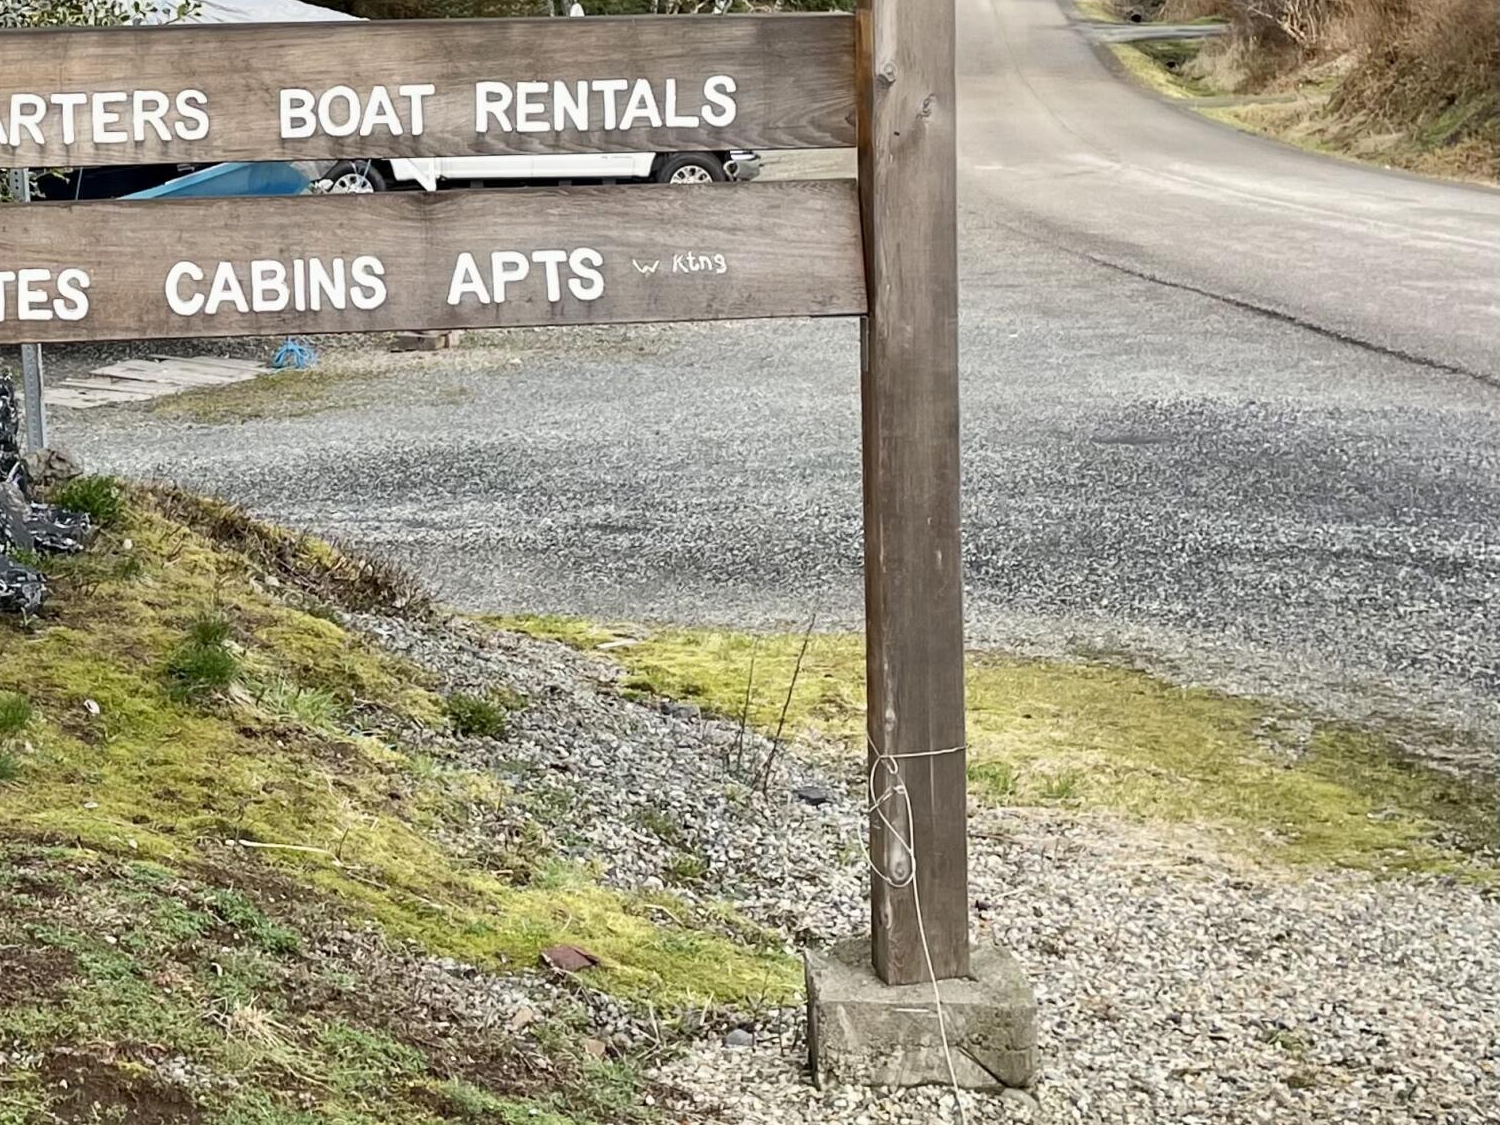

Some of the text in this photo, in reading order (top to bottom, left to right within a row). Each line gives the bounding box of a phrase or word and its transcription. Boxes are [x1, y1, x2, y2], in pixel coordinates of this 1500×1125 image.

[279, 83, 436, 139] BOAT
[475, 75, 737, 134] RENTALS
[165, 255, 387, 316] CABINS
[447, 247, 605, 305] APTS
